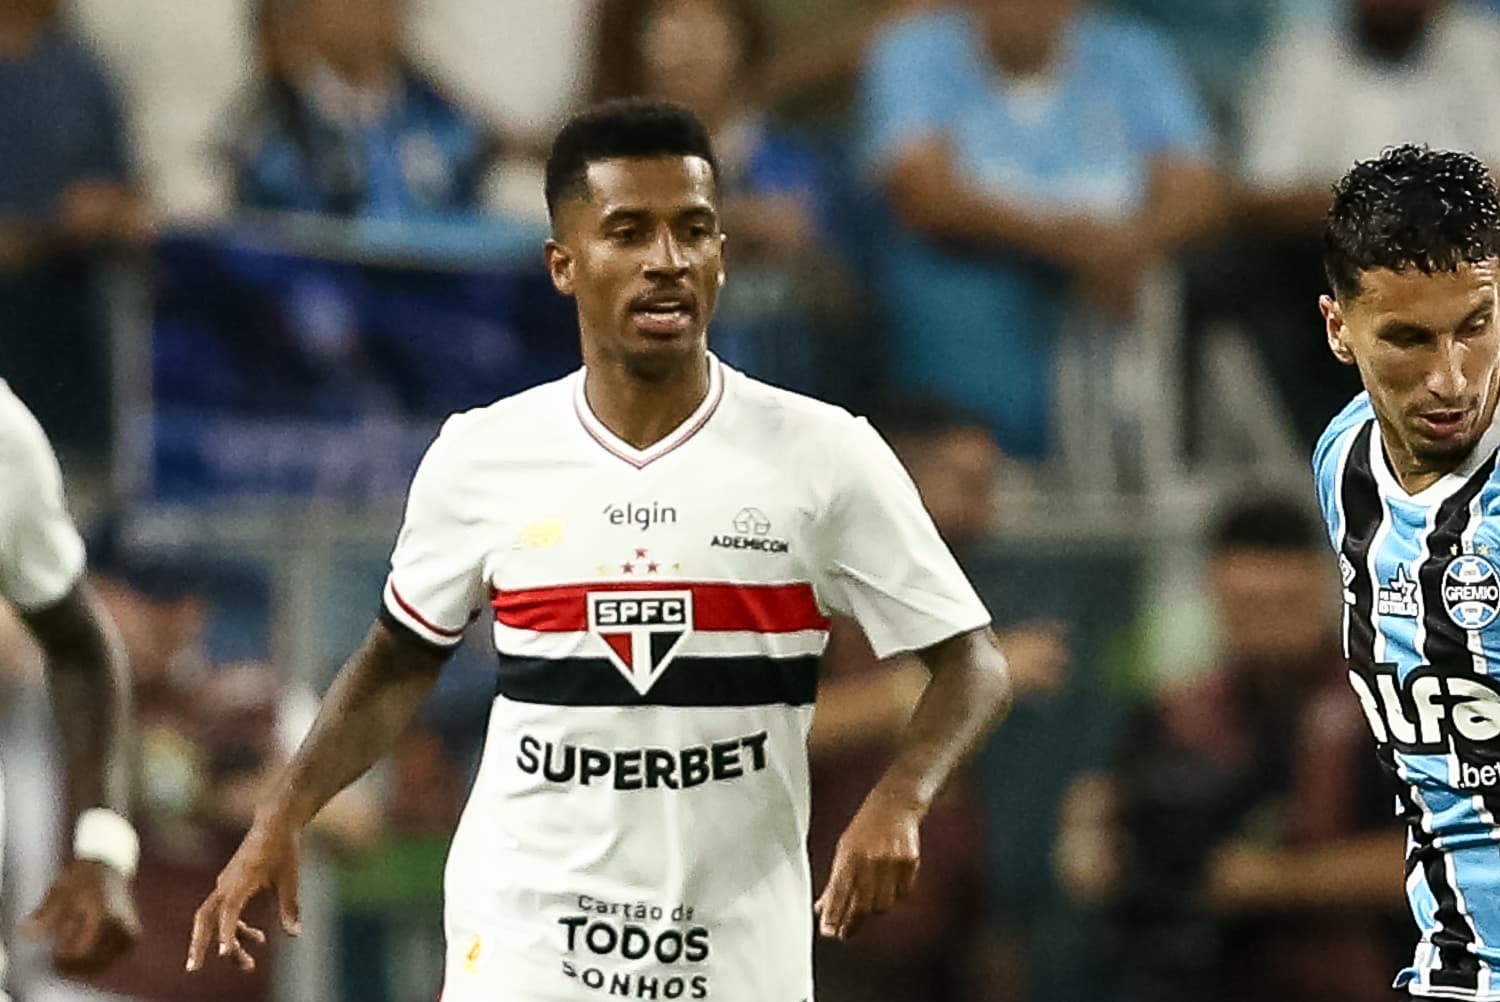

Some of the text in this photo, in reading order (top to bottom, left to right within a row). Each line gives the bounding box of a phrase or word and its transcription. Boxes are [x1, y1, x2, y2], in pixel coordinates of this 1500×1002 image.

[598, 601, 684, 624] SPFC
[517, 732, 769, 791] SUPERBET
[578, 895, 663, 920] Cartão
[558, 916, 709, 964] TODOS
[562, 960, 707, 999] SONHOS
